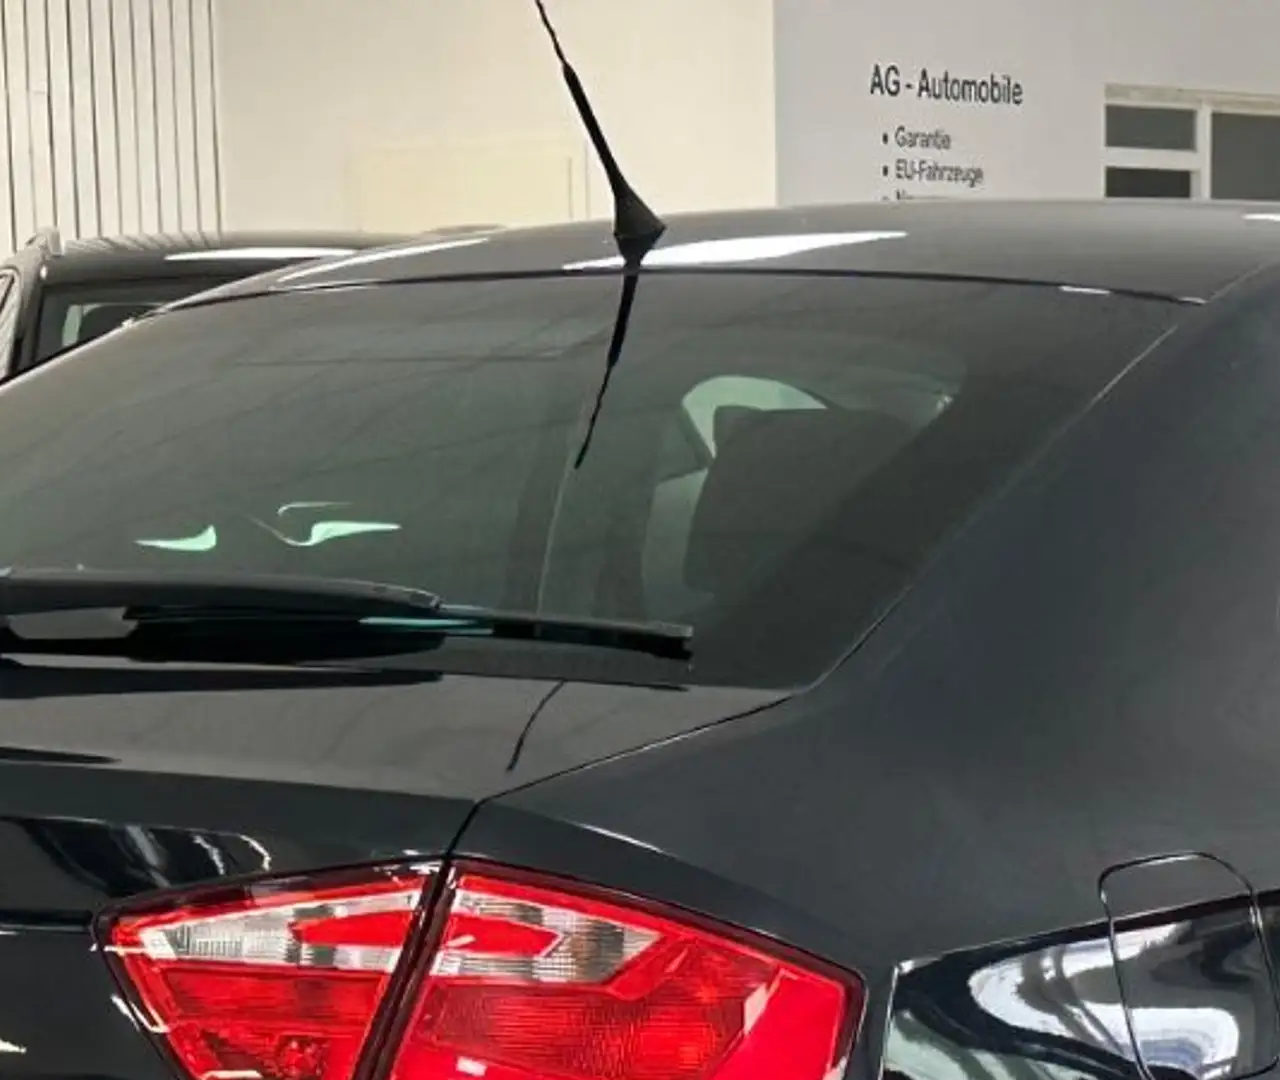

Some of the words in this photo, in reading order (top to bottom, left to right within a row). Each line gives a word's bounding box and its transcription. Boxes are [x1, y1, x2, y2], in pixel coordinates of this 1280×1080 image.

[870, 64, 901, 97] AG
[917, 68, 1024, 106] Automobile
[894, 125, 952, 150] Garantie
[894, 157, 985, 189] EU-Fahrzeuge
